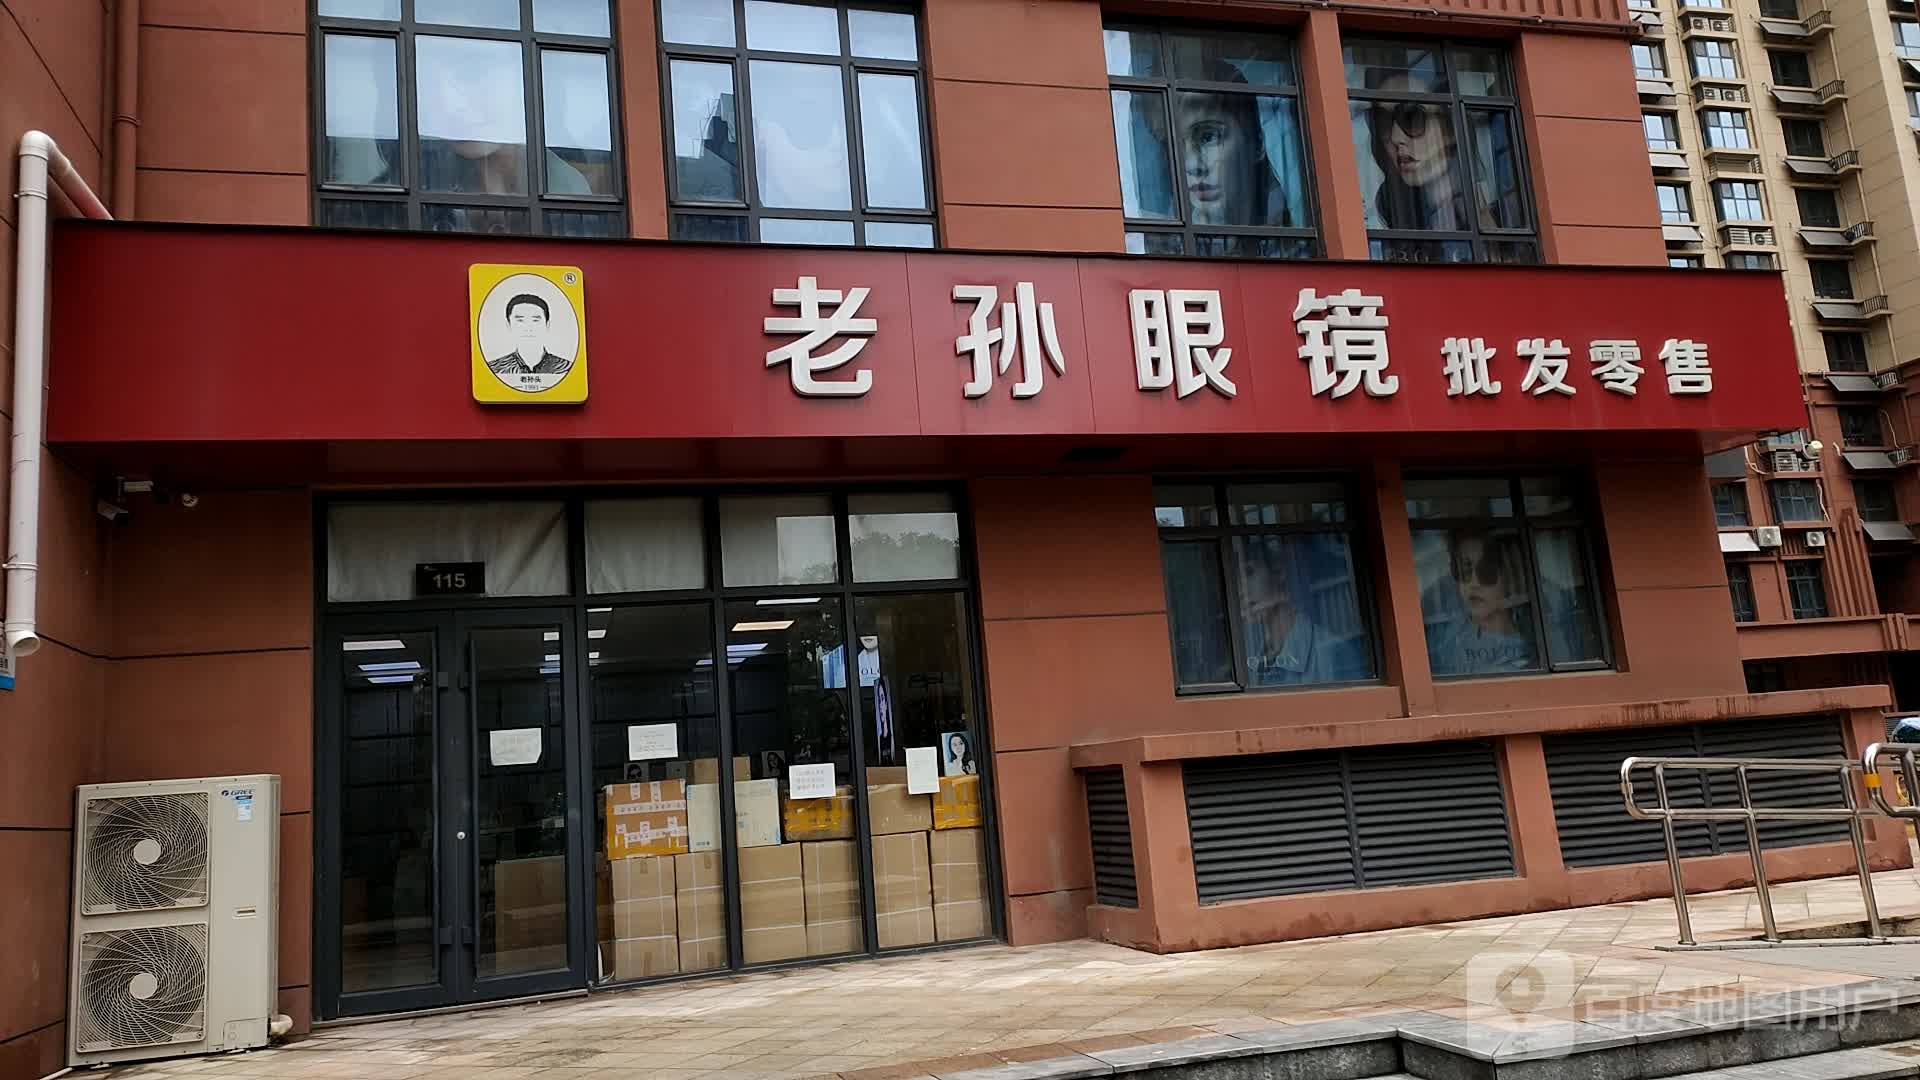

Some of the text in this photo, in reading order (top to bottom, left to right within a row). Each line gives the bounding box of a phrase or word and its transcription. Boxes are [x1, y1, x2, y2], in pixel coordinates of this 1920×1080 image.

[764, 276, 1399, 399] 老孙眼镜
[1441, 338, 1712, 396] 批发零售
[432, 573, 466, 588] 115
